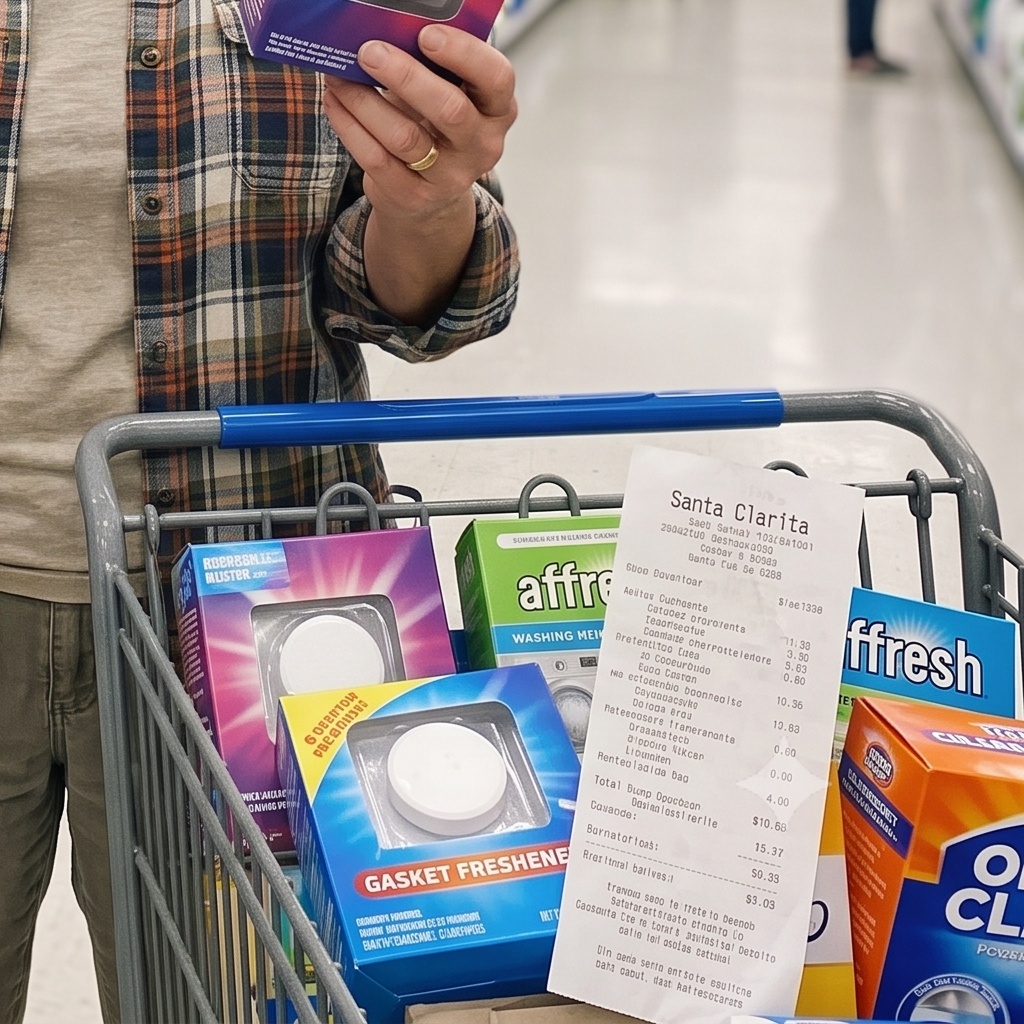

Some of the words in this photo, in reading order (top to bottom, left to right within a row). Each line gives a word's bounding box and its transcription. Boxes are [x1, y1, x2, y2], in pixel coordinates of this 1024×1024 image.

[670, 489, 723, 518] Santa
[734, 502, 809, 535] Clarita
[517, 560, 614, 612] affre
[512, 631, 574, 644] WASHING
[844, 617, 985, 698] ffresh
[777, 696, 803, 710] 10.36
[594, 774, 621, 790] Total
[770, 769, 793, 782] 0.00
[766, 793, 789, 807] 4.00
[755, 842, 784, 858] 15.37
[364, 865, 451, 894] GASKET
[457, 847, 572, 881] FRESHENE
